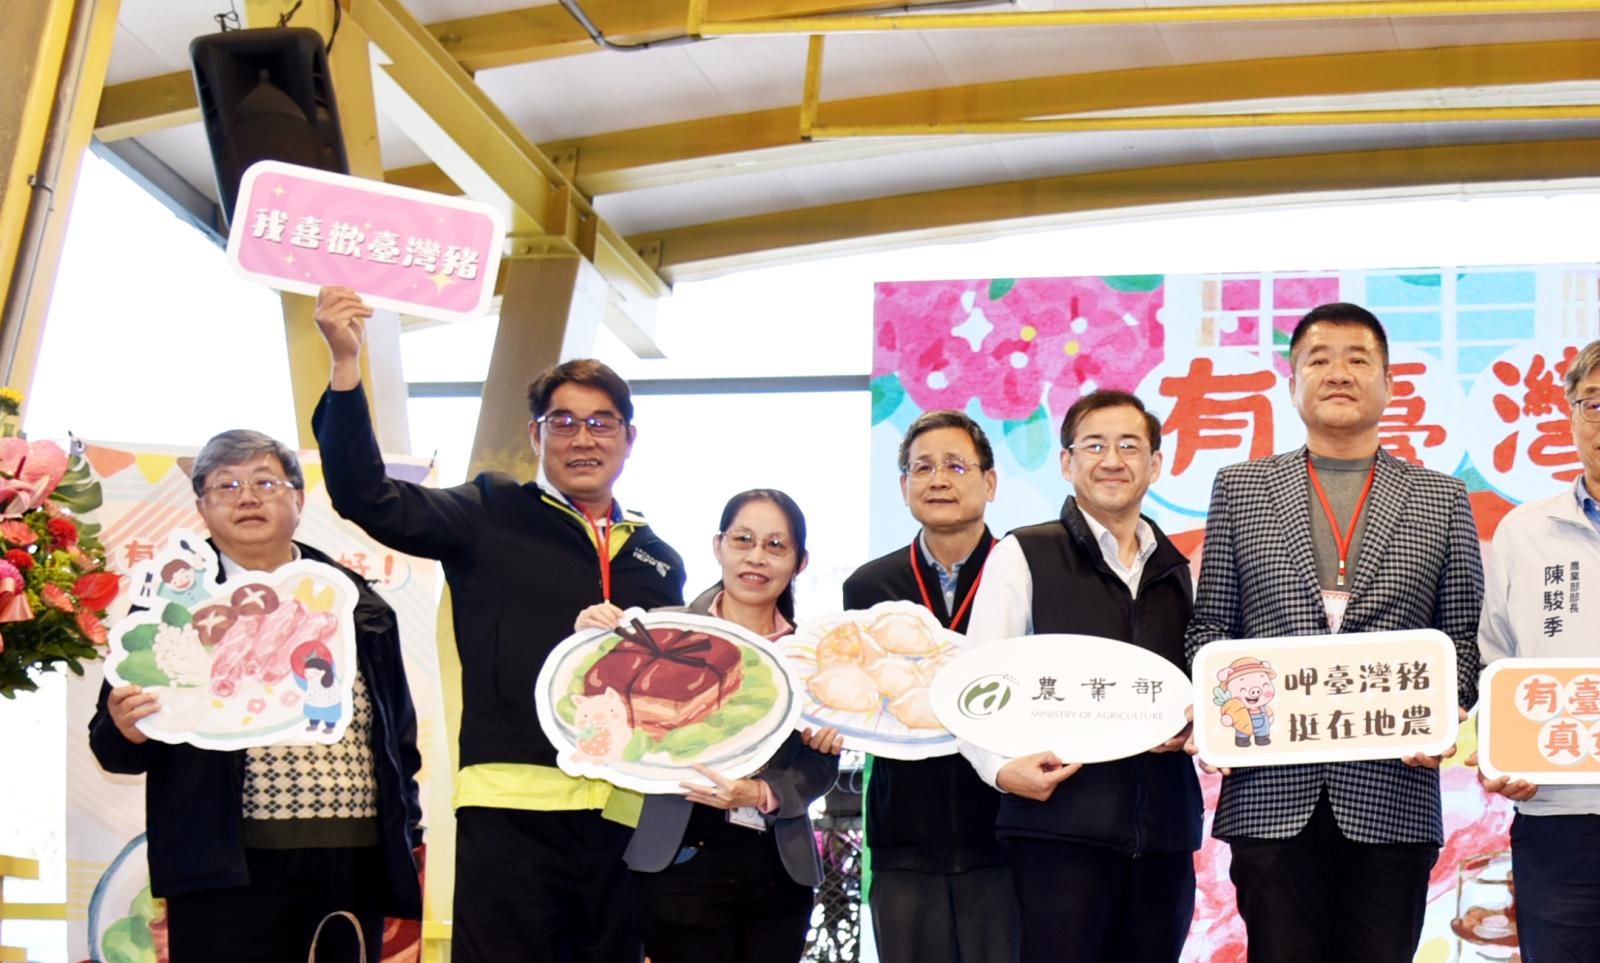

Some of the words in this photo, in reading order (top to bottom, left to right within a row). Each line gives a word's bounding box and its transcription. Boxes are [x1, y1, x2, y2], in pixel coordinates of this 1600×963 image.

[252, 207, 480, 280] 我喜歡臺灣豬
[1543, 563, 1565, 638] 陳駿季
[1569, 560, 1580, 614] 農業部部長
[1031, 676, 1164, 703] 農業部
[1284, 659, 1430, 696] 呷臺灣豬
[1031, 711, 1076, 719] MINISTRY
[1079, 711, 1092, 719] OF
[1095, 711, 1164, 720] AGRICULTURE
[1289, 704, 1432, 743] 挺在地農
